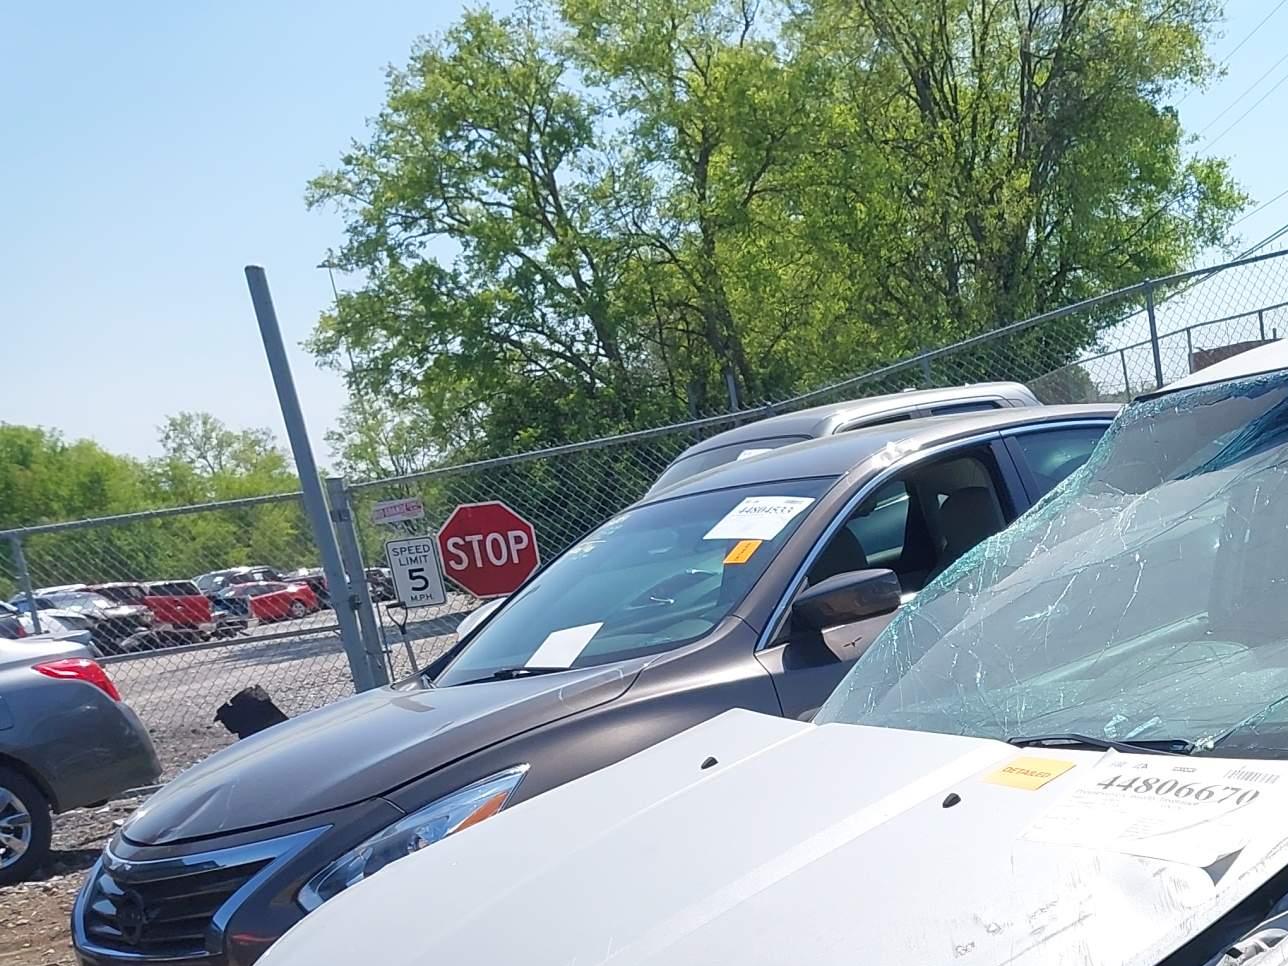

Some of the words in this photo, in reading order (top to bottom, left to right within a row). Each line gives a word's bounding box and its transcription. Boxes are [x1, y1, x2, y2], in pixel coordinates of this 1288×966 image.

[391, 544, 430, 557] SPEED
[447, 530, 528, 570] STOP
[398, 555, 428, 567] LIMIT
[408, 567, 429, 591] 5
[1001, 765, 1052, 778] DETAILED
[1097, 774, 1260, 805] 44806670
